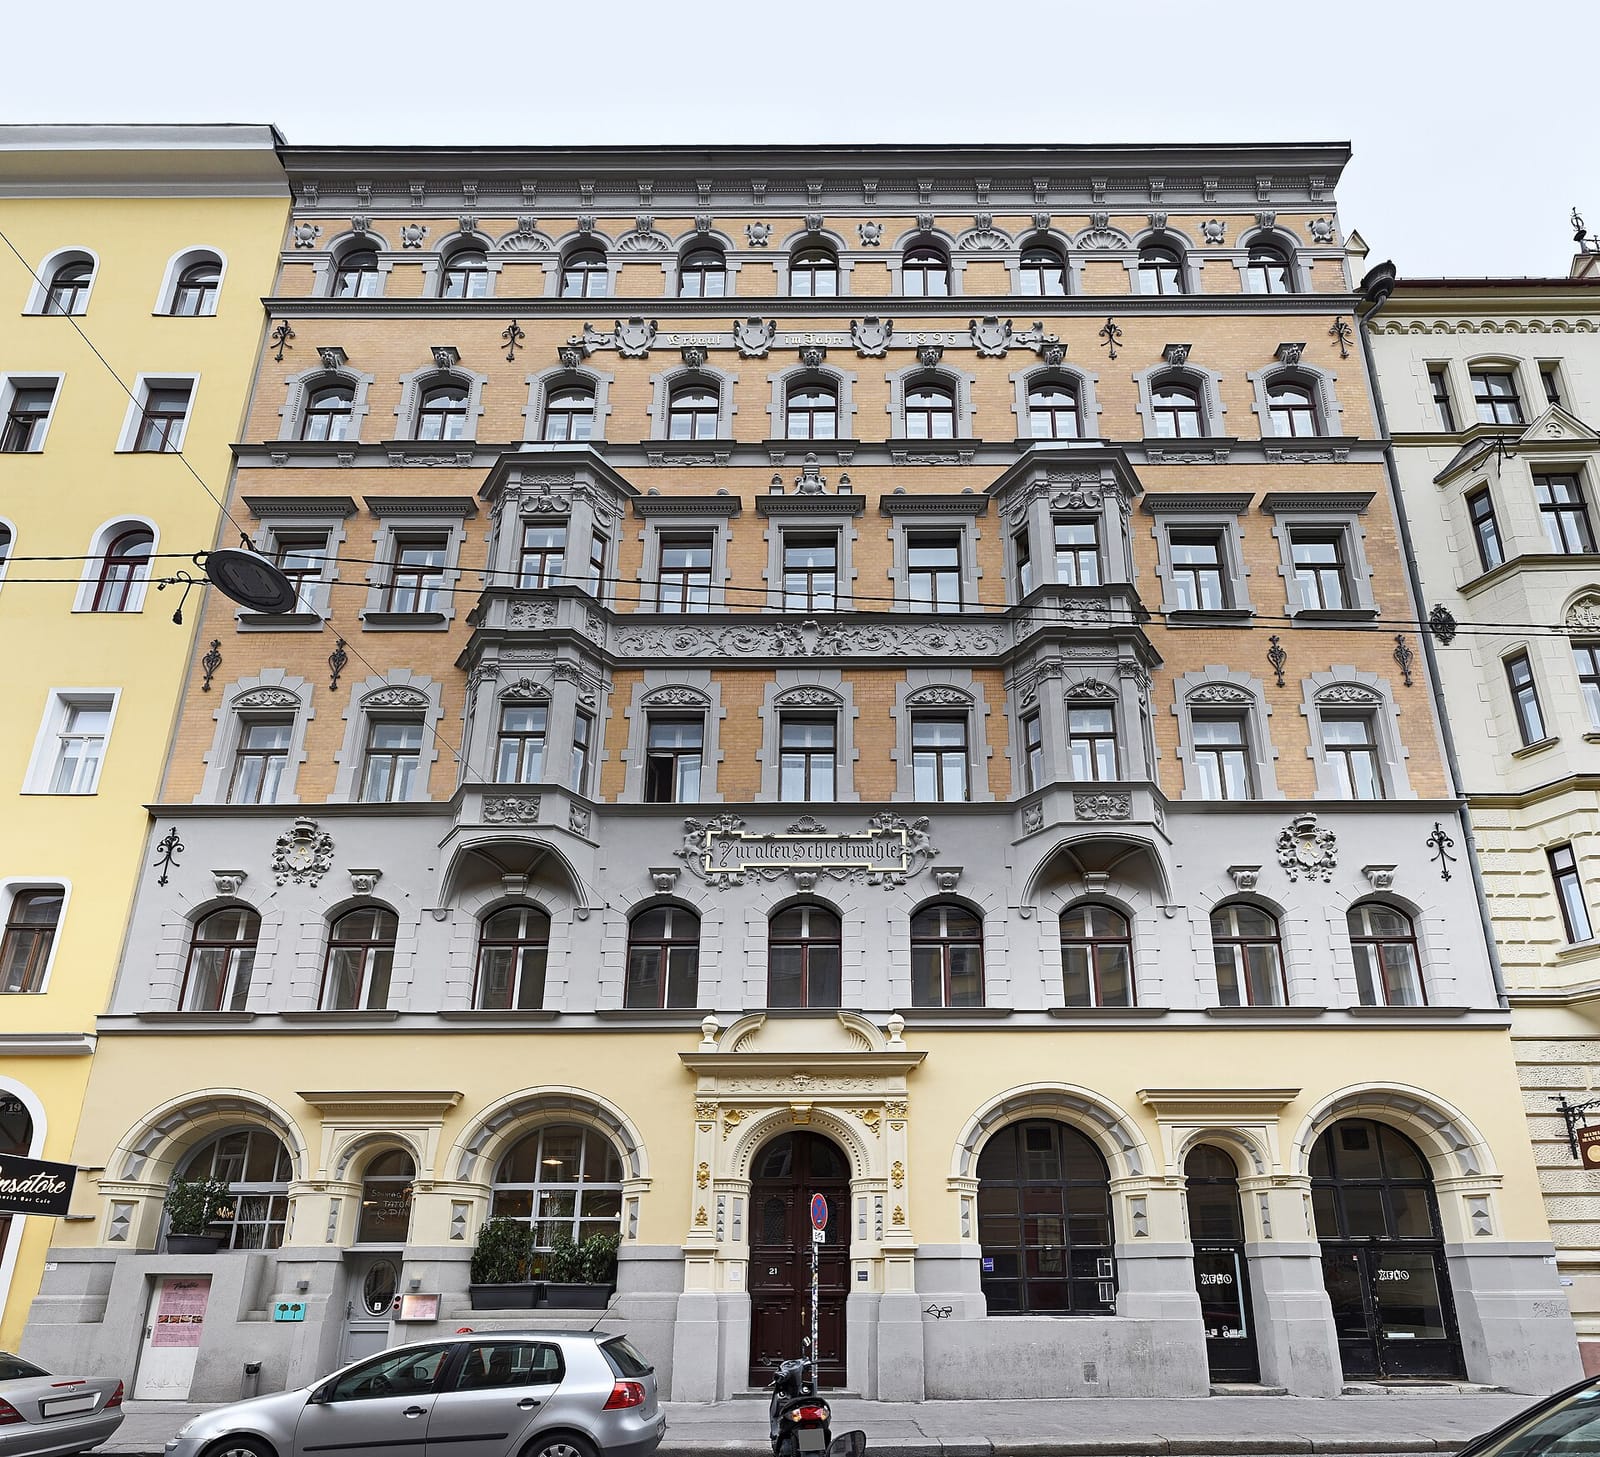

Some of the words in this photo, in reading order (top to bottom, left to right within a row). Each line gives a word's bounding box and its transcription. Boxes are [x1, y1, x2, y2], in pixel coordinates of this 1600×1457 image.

[784, 334, 801, 345] im
[905, 333, 957, 346] 1895
[718, 838, 753, 867] Zur
[756, 842, 791, 859] alten
[0, 1167, 66, 1194] nsatore
[769, 1267, 778, 1275] 21
